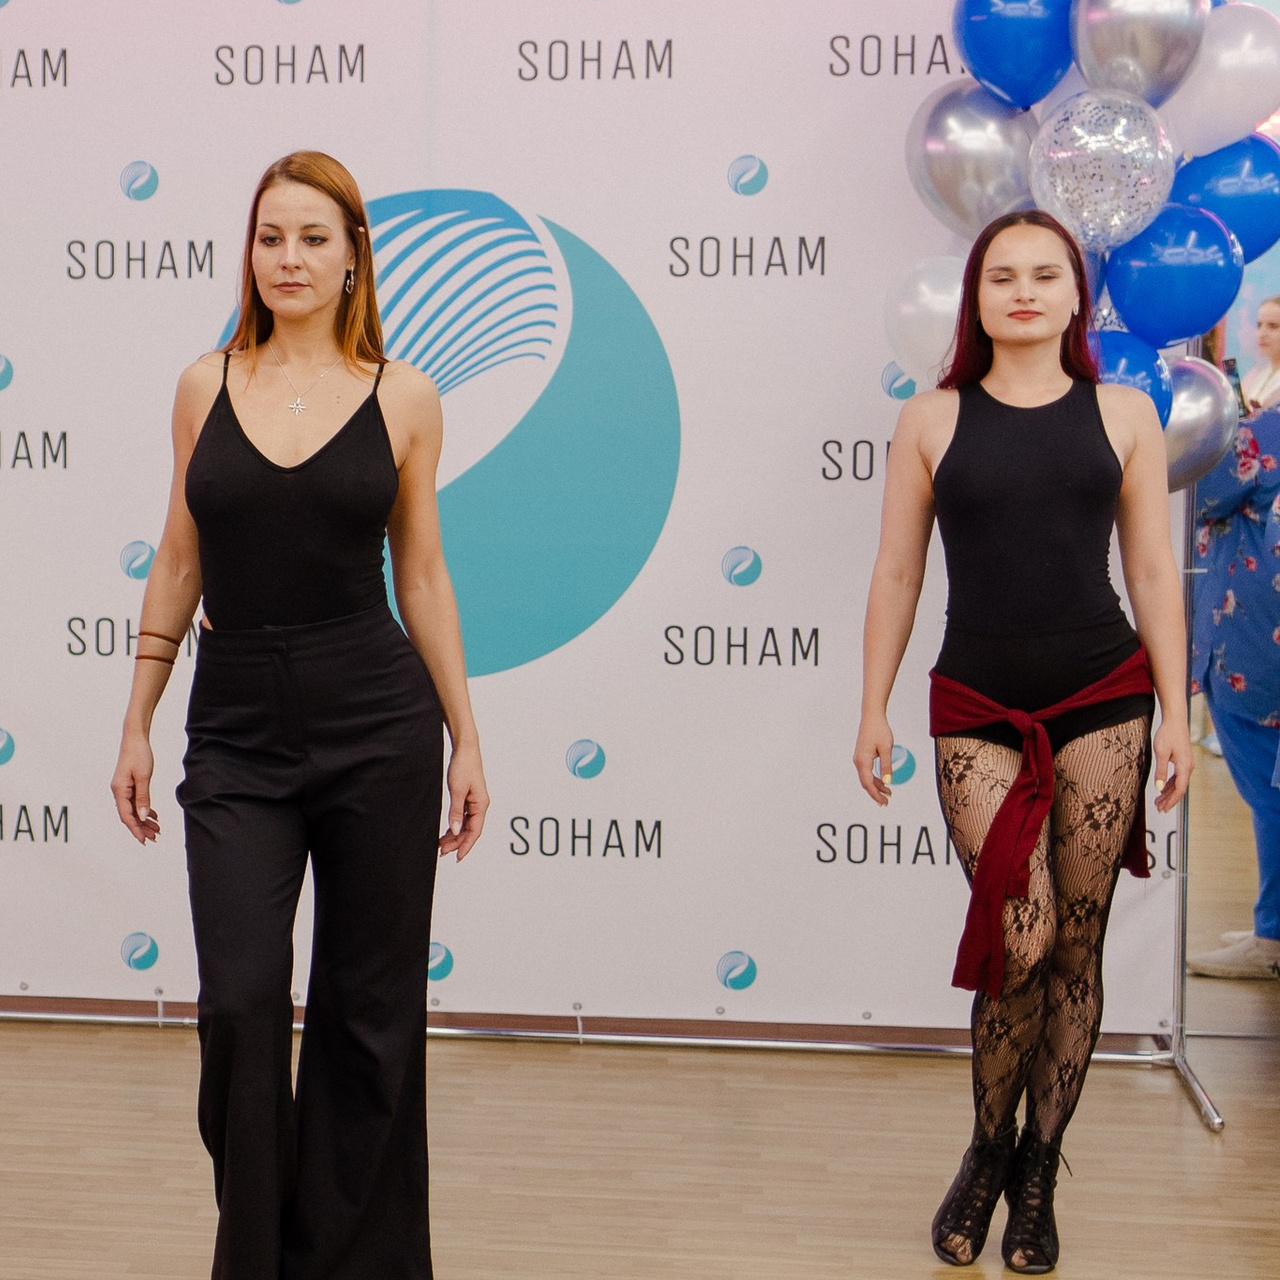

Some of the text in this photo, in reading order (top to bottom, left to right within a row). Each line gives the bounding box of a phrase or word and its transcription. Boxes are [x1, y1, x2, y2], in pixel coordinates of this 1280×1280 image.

[214, 42, 366, 87] SOHAM
[517, 38, 674, 82] SOHAM
[828, 33, 966, 77] SOHA
[66, 239, 214, 280] SOHAM
[668, 235, 826, 278] SOHAM
[821, 439, 891, 482] SO
[663, 624, 820, 667] SOHAM
[509, 815, 662, 859] SOHAM
